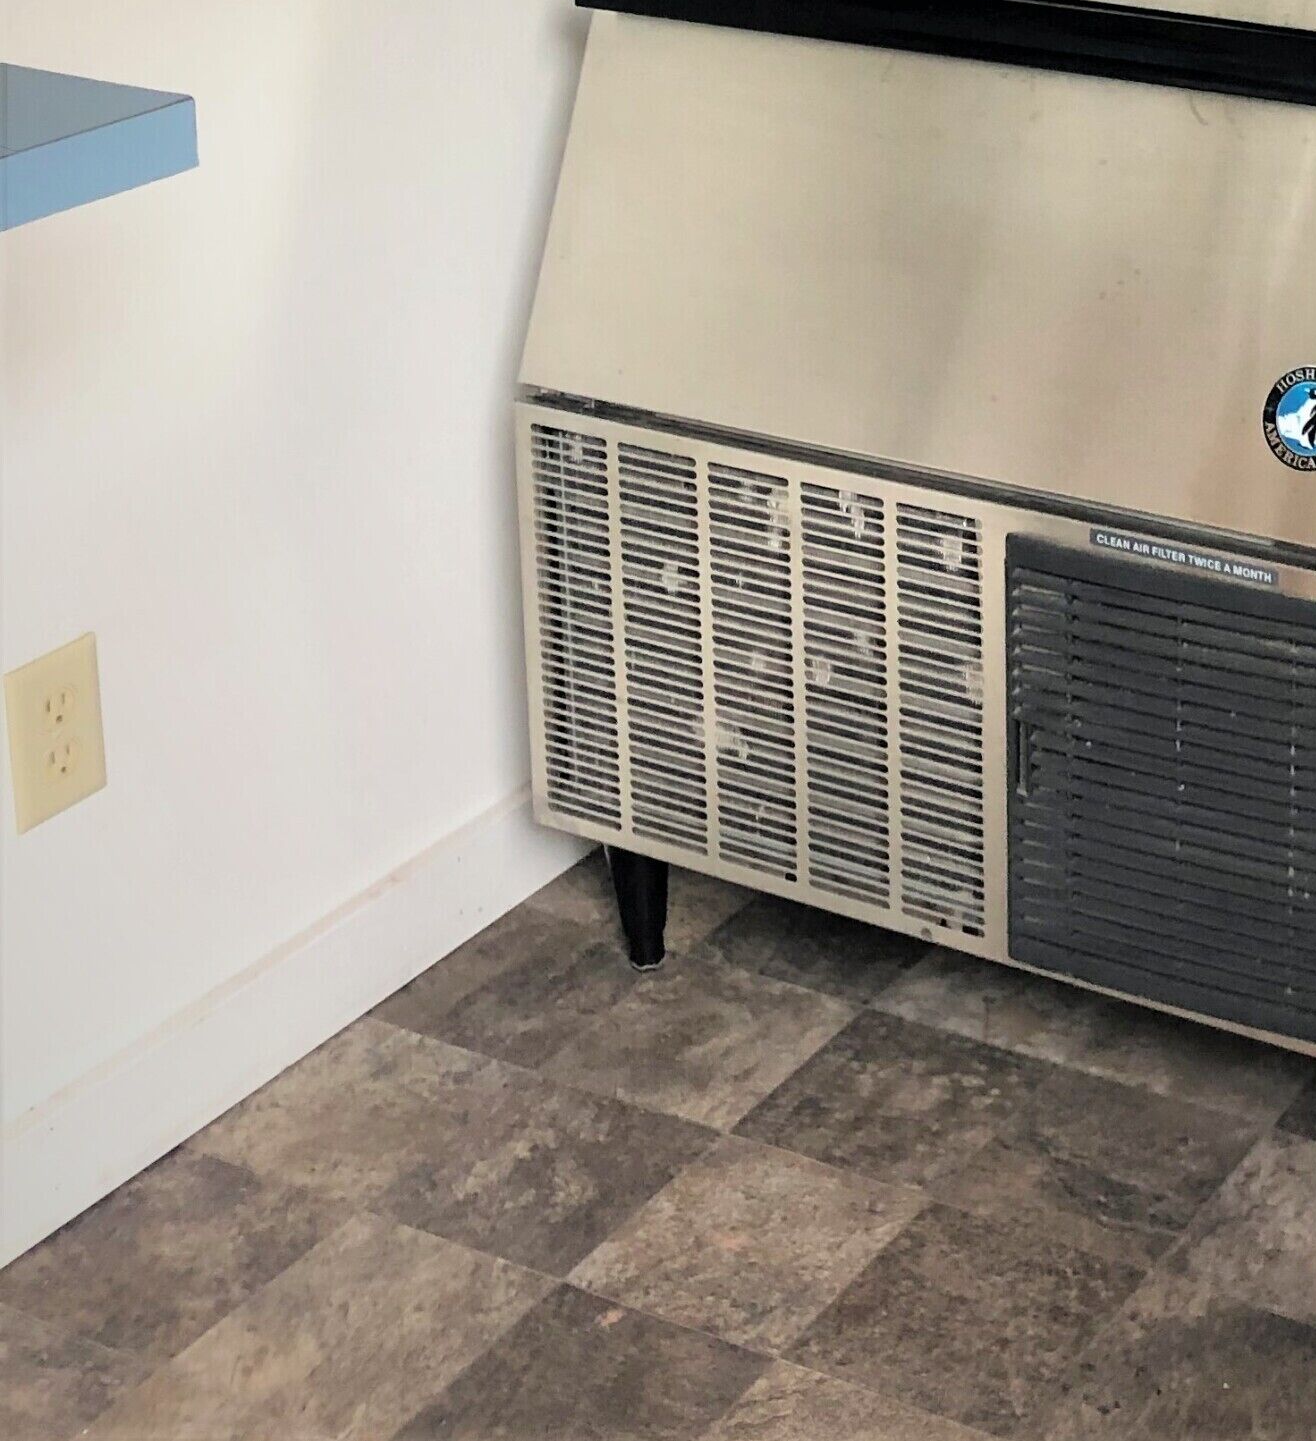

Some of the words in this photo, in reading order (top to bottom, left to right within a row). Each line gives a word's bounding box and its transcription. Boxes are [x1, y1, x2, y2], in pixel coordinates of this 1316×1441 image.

[1096, 534, 1130, 550] CLEAN
[1132, 542, 1150, 555] AIR
[1151, 546, 1186, 563] FILTER
[1188, 554, 1221, 572] TWICE
[1223, 564, 1231, 574] A
[1232, 566, 1272, 584] MONTH
